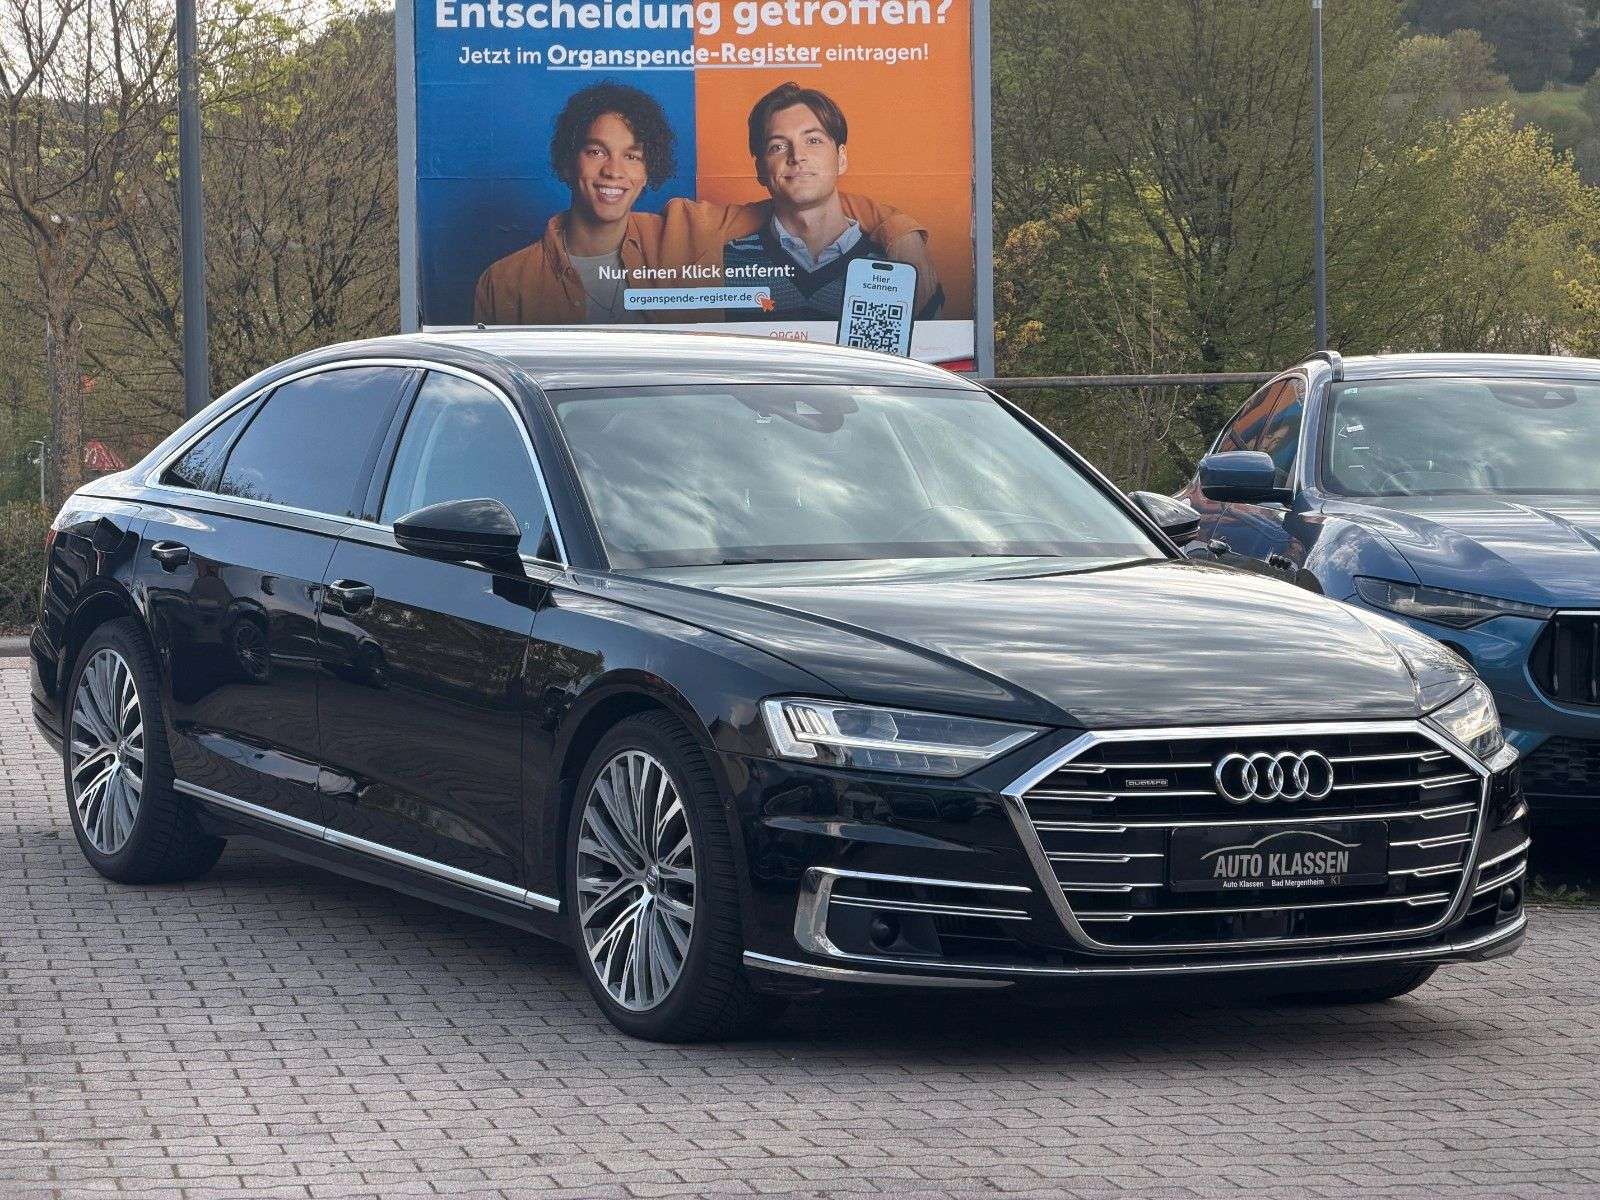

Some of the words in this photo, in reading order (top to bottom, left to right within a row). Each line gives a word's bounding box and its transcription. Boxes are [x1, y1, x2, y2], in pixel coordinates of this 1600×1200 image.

[436, 0, 720, 35] Entscheidung
[733, 0, 952, 35] getroffen?
[458, 47, 511, 65] Jetzt
[516, 46, 542, 65] im
[547, 43, 821, 69] Organspende-Register
[825, 43, 929, 65] eintragen!
[598, 265, 628, 280] Nur
[632, 265, 677, 280] einen
[682, 264, 721, 279] Klick
[725, 264, 795, 278] entfernt:
[872, 274, 891, 284] Hier
[863, 282, 898, 293] scannen
[629, 292, 752, 304] organspende-register.de
[1213, 854, 1263, 878] AUTO
[1268, 851, 1349, 877] KLASSEN
[1222, 880, 1238, 889] Auto
[1239, 880, 1265, 888] Klassen
[1271, 879, 1284, 888] Bad
[1285, 878, 1326, 889] Mergentheim
